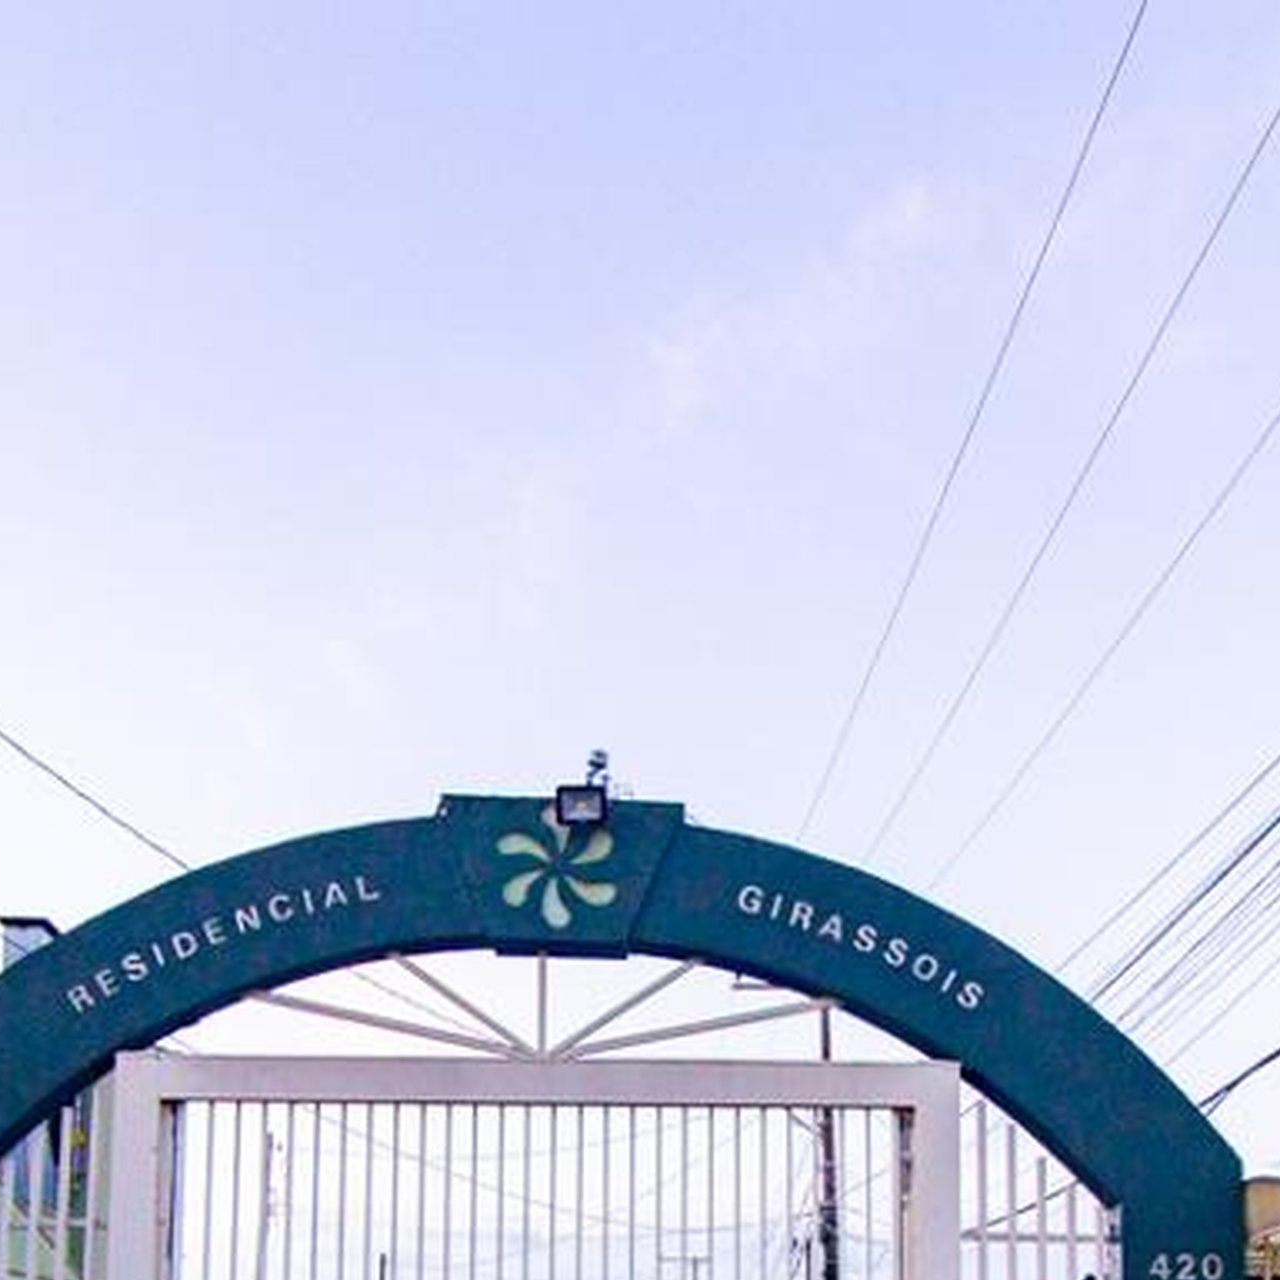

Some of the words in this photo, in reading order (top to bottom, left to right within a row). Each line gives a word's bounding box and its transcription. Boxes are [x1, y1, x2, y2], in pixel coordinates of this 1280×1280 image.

[67, 876, 380, 1012] RESIDENCIAL
[737, 885, 985, 1009] GIRASSOIS
[1149, 1253, 1224, 1280] 420
